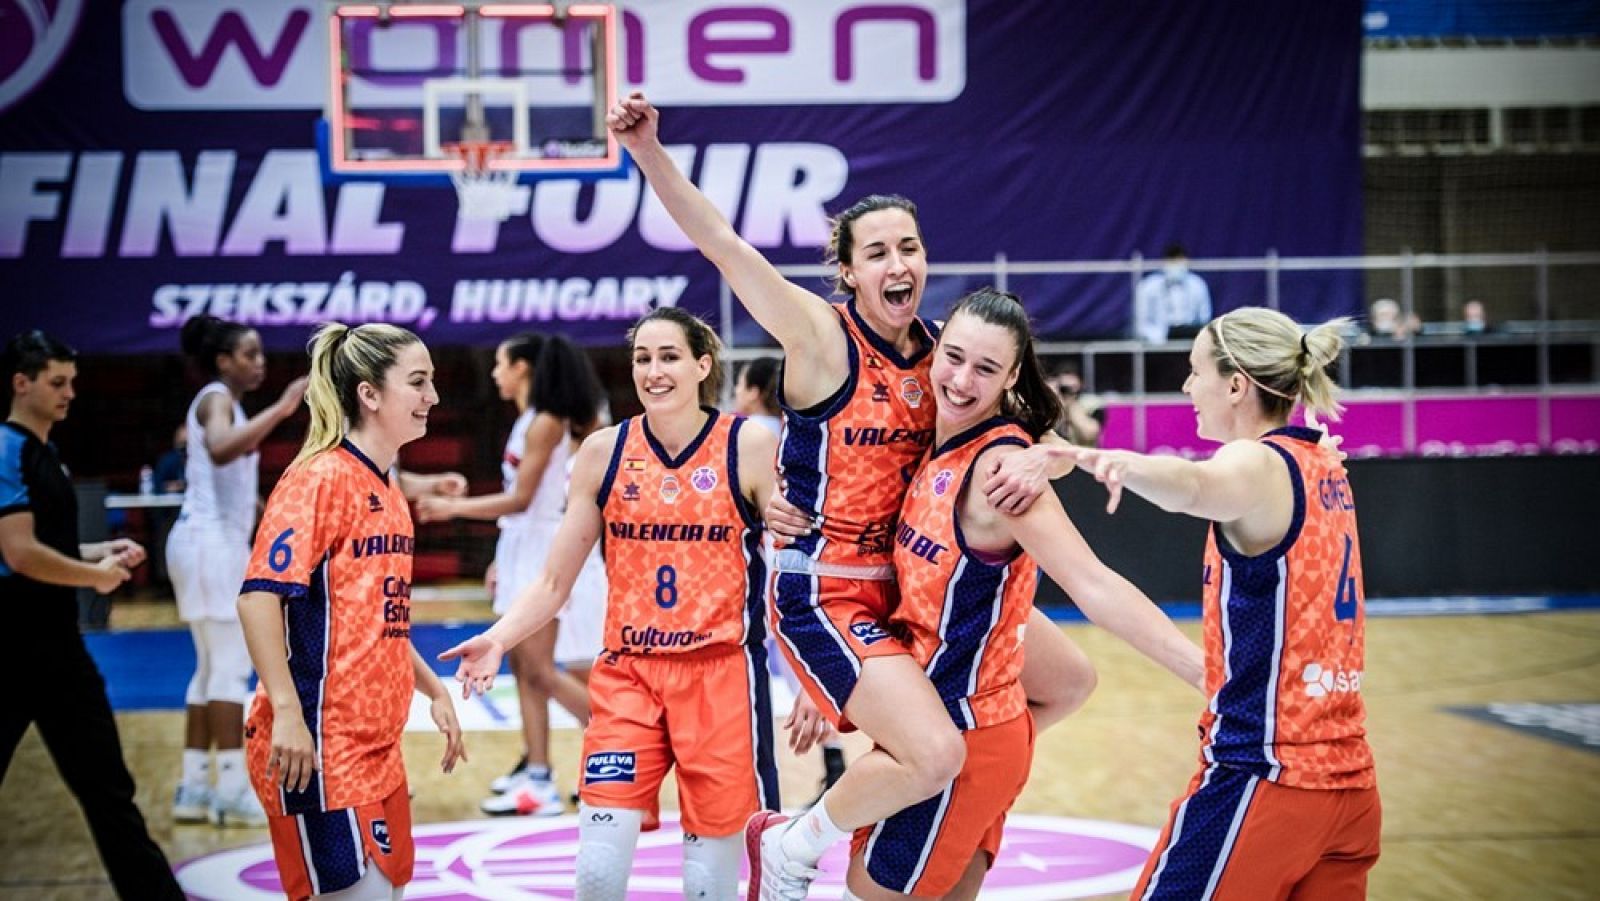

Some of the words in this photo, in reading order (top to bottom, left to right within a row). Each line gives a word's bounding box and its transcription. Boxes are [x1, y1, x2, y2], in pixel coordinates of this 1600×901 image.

[150, 6, 936, 88] women
[0, 149, 405, 258] FINAL
[149, 272, 437, 328] SZEKSZÁRD,
[449, 275, 688, 322] HUNGARY
[268, 527, 295, 573] 6
[609, 522, 704, 542] VALENCIA
[708, 525, 734, 542] BC
[911, 535, 949, 566] BC
[655, 564, 679, 609] 8
[1334, 532, 1358, 640] 4
[621, 625, 693, 648] Cultura
[587, 753, 634, 768] PULEVA
